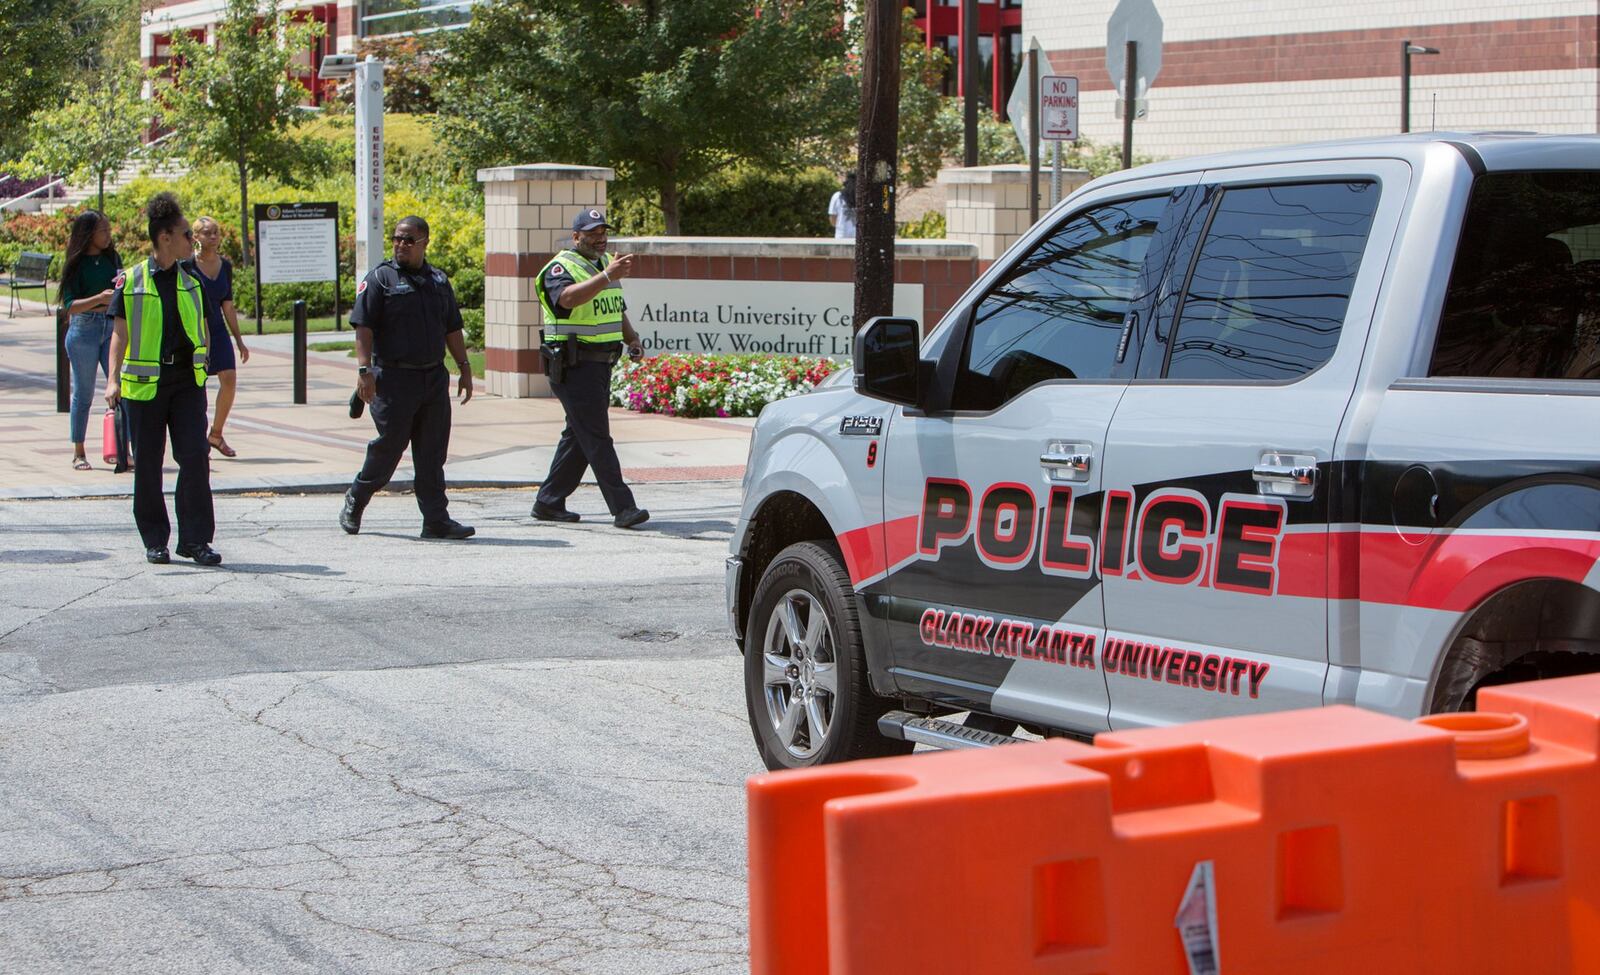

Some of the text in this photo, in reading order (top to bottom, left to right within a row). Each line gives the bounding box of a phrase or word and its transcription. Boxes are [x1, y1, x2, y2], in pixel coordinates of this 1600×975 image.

[1043, 95, 1077, 109] PARKING
[1053, 81, 1068, 94] NO
[372, 126, 380, 200] EMERGENCY
[640, 303, 855, 332] Atlanta University Ce
[641, 330, 856, 356] obert W. Woodruff Li
[866, 439, 878, 469] 9
[918, 476, 1285, 597] POLICE
[919, 608, 1270, 699] CLARK ATLANTA UNIVERSITY
